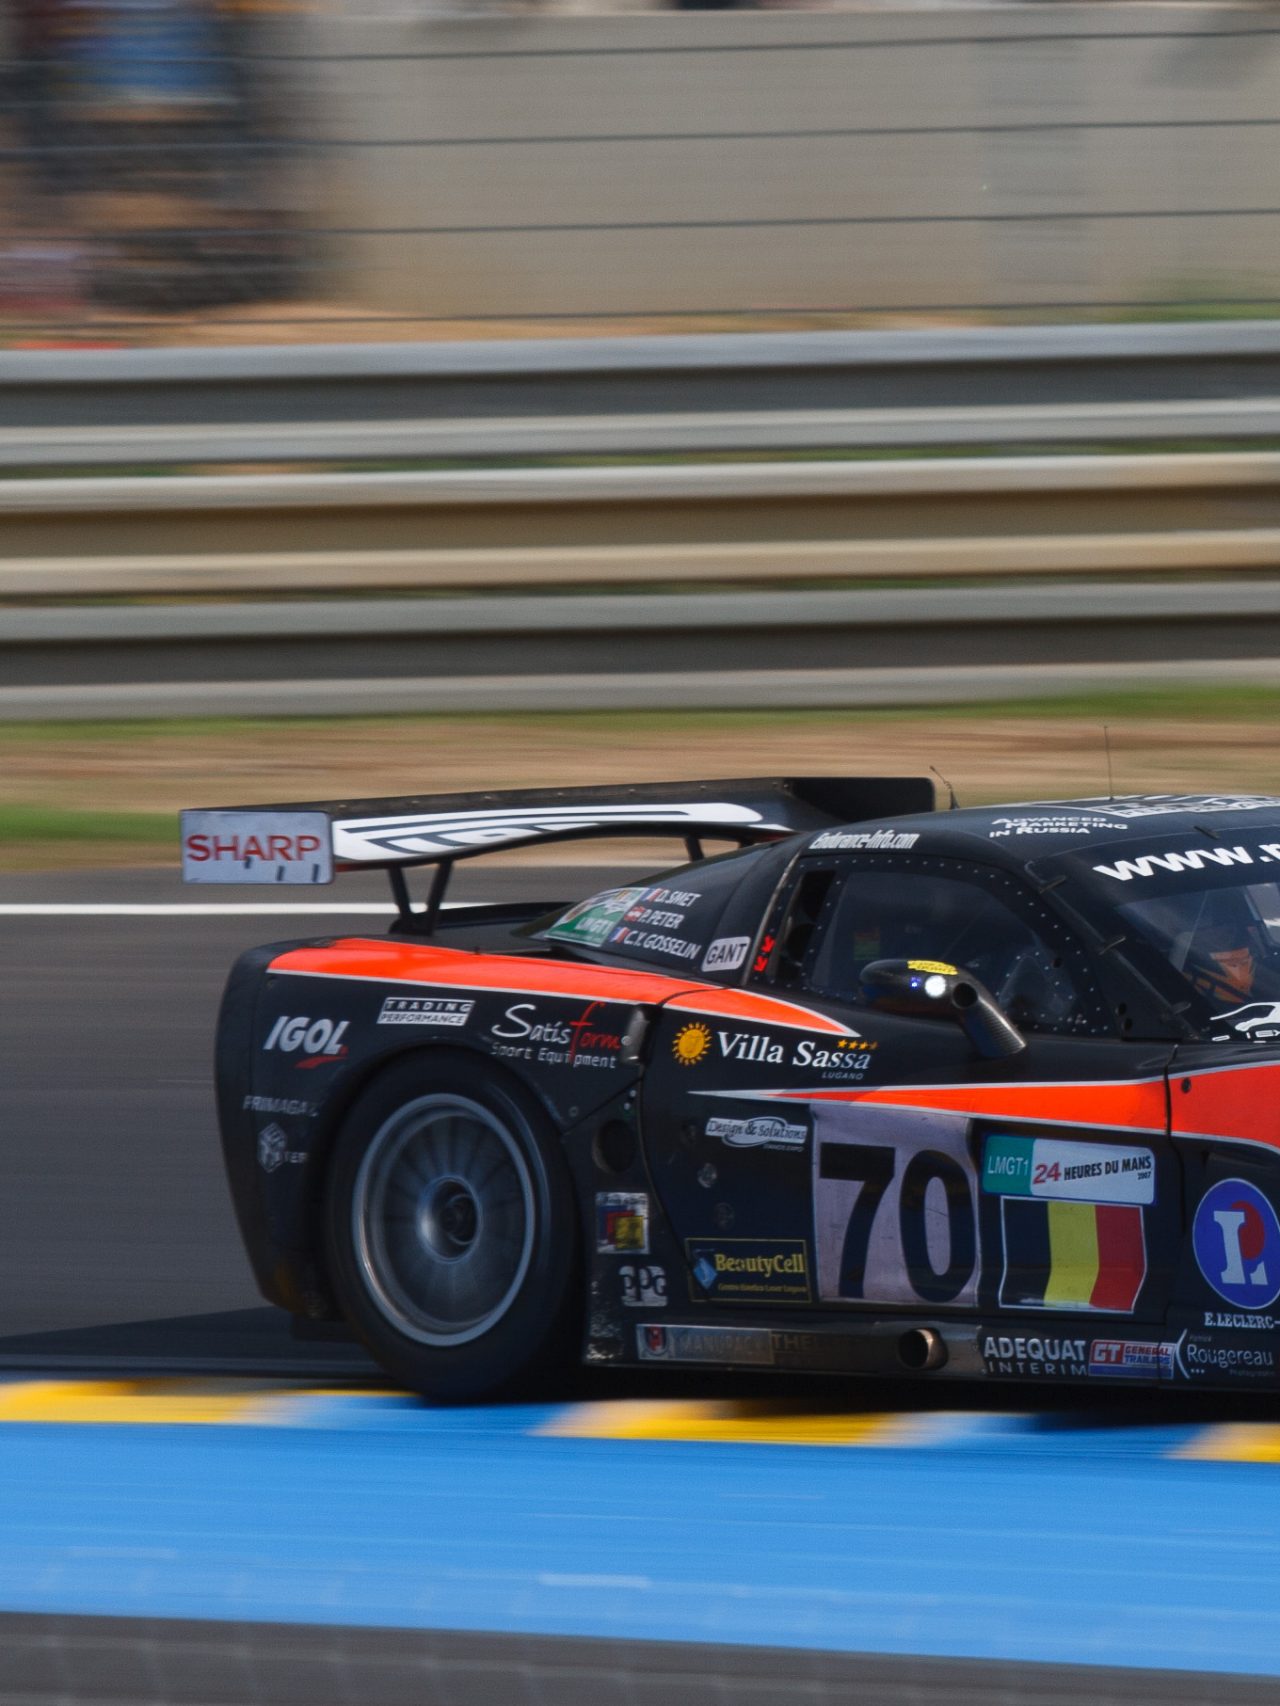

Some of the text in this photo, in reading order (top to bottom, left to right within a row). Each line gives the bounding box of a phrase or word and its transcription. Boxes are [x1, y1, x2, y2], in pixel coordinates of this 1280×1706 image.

[1016, 825, 1091, 835] RUSSIA
[186, 834, 321, 862] SHARP
[706, 943, 747, 965] GANT
[386, 1000, 473, 1012] TRADING
[263, 1016, 351, 1055] IGOL
[717, 1031, 872, 1070] Villa Sassa
[821, 1071, 864, 1081] LUGANO
[987, 1153, 1029, 1176] LMGT1
[1033, 1156, 1152, 1185] 24 HEURES DU MANS
[820, 1142, 977, 1304] 70
[715, 1253, 806, 1278] BeautyCell
[984, 1336, 1086, 1361] ADEQUAT
[1094, 1343, 1121, 1361] GT
[1186, 1343, 1274, 1369] Rougereau
[988, 1361, 1087, 1377] INTERIM
